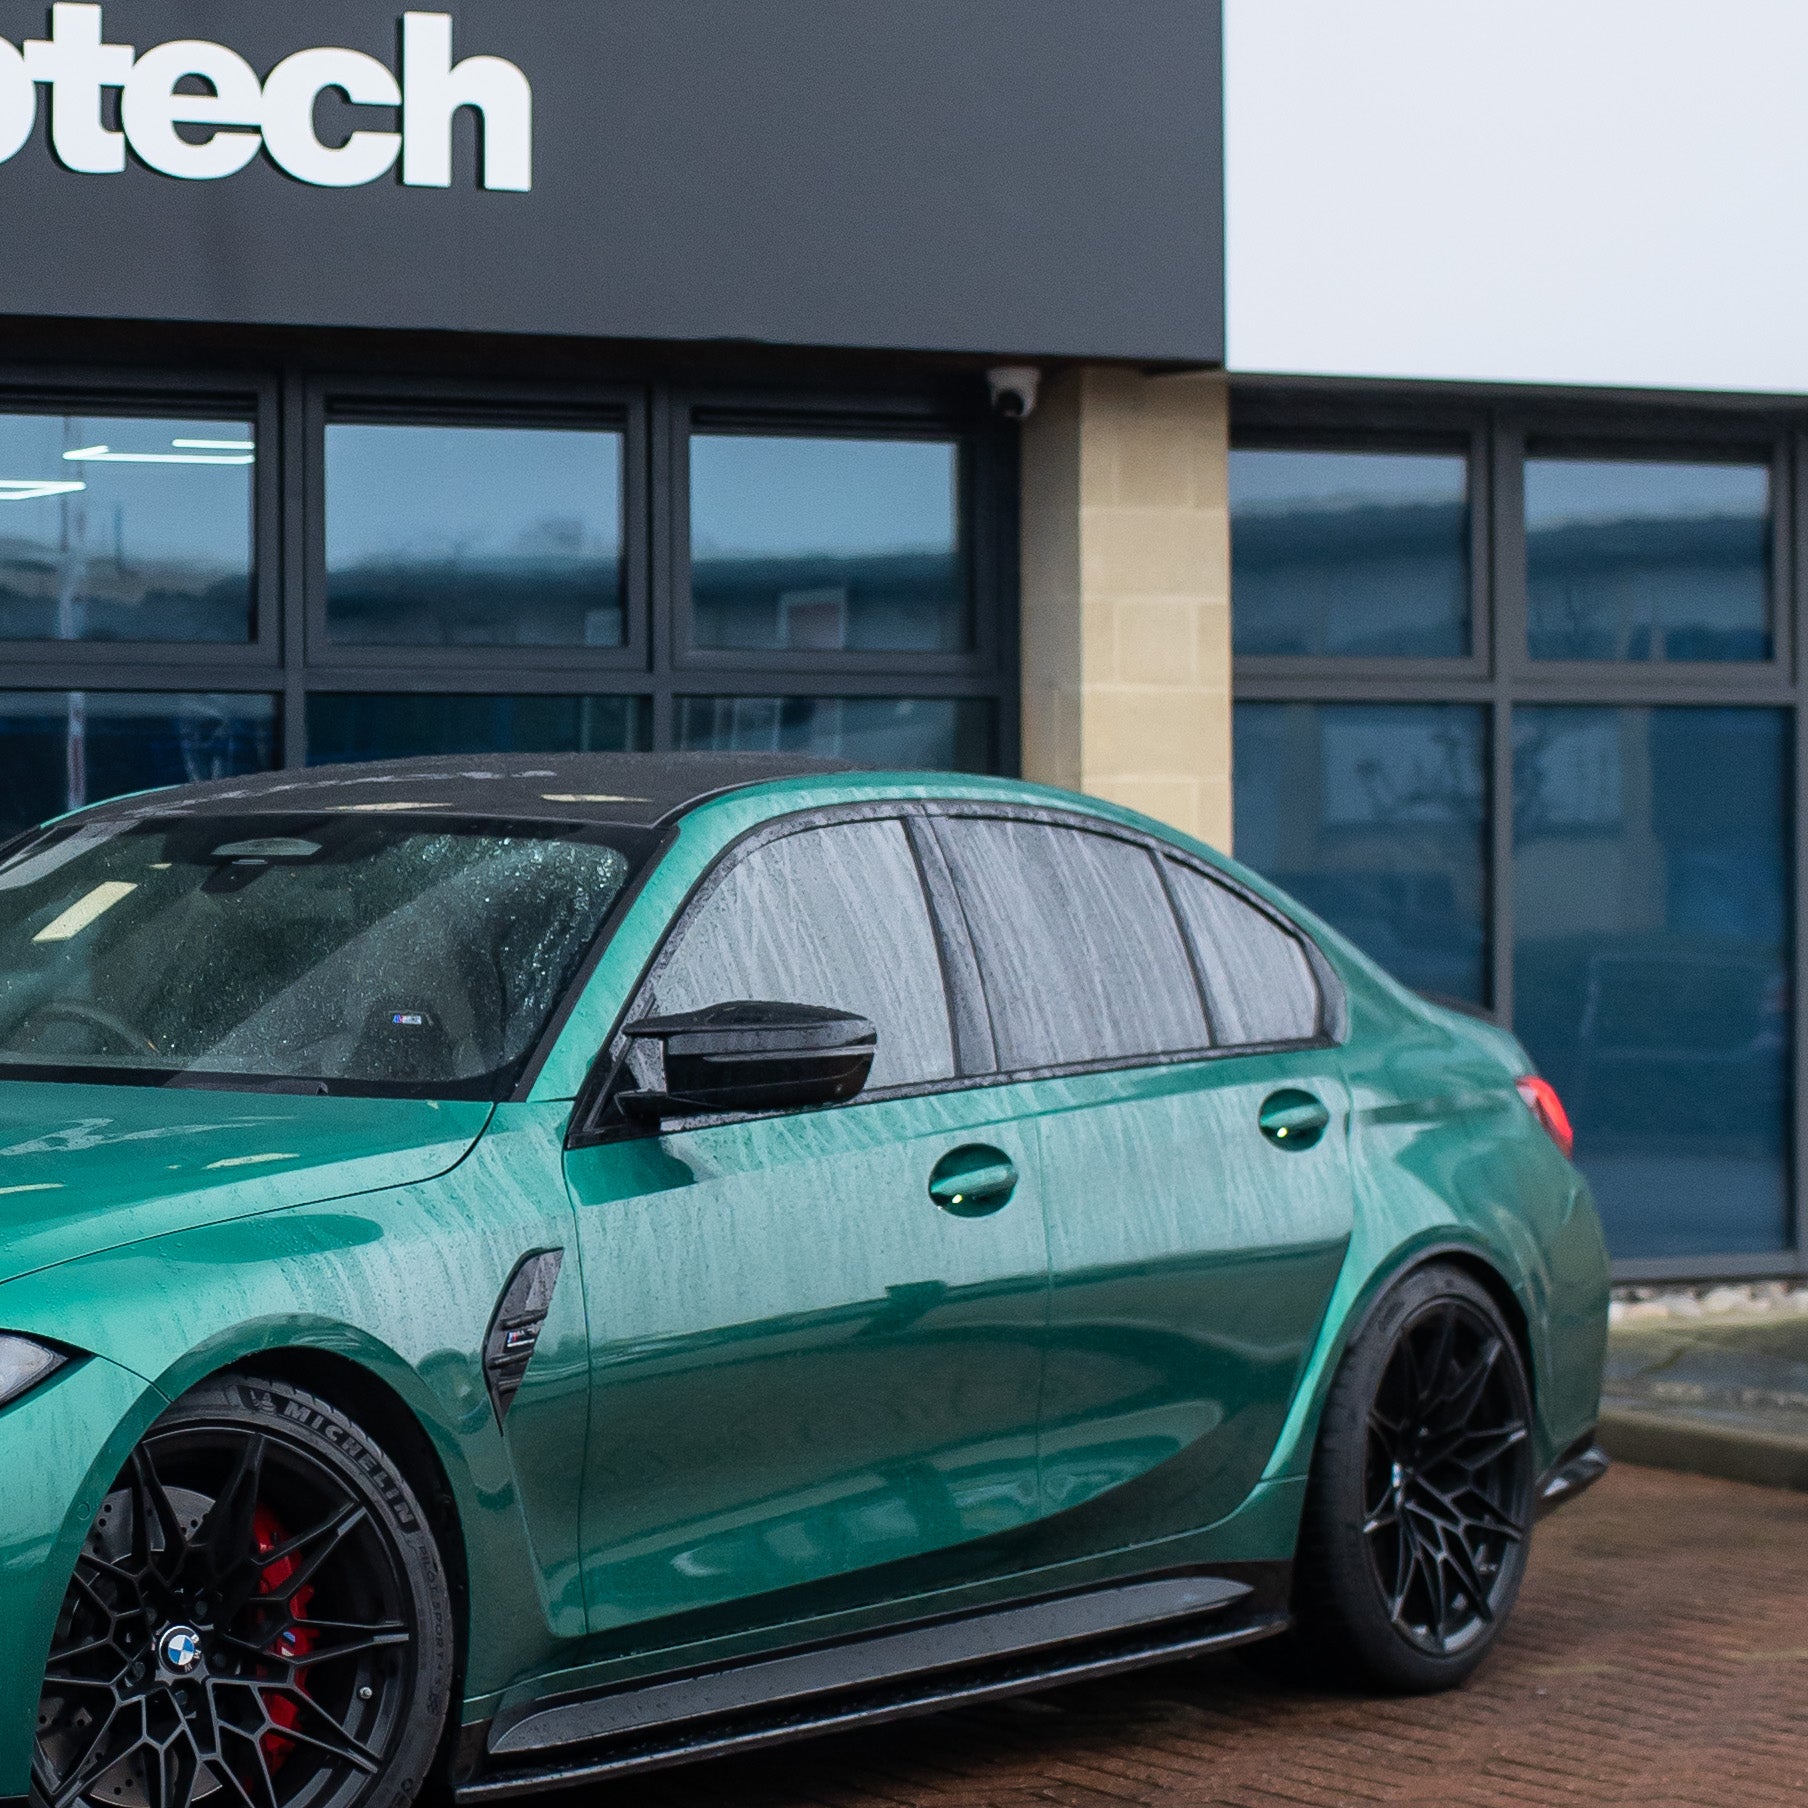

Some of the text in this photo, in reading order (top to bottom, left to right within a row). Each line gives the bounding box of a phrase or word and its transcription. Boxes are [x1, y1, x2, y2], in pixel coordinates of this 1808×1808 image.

[283, 1400, 414, 1524] MICHELIN
[419, 1545, 438, 1592] PILOT
[432, 1601, 444, 1659] SPORT
